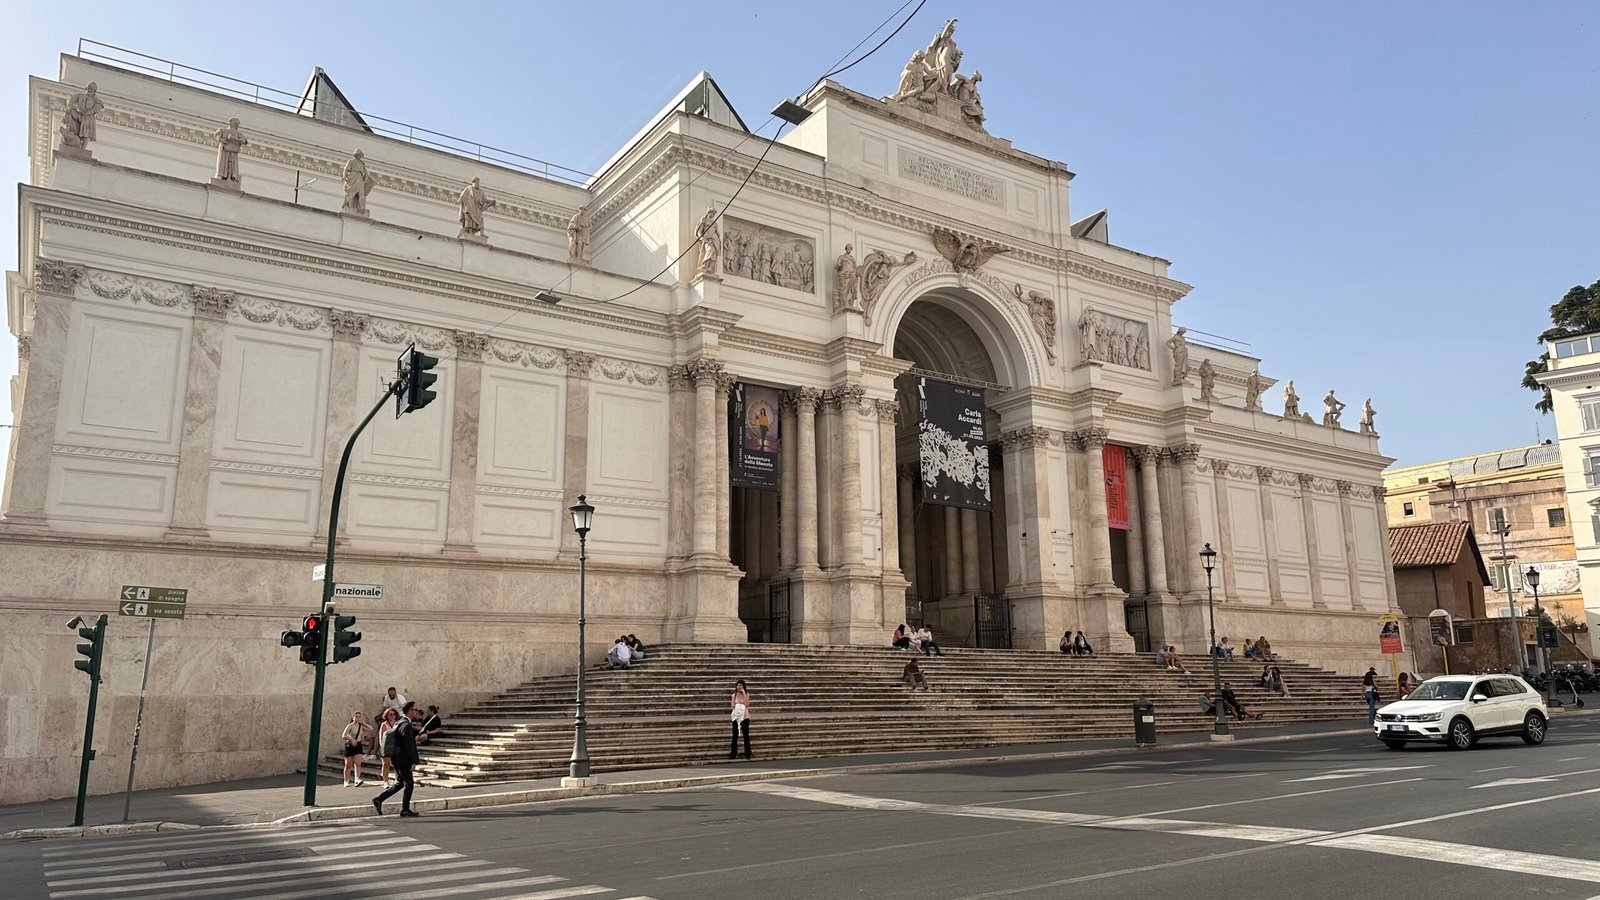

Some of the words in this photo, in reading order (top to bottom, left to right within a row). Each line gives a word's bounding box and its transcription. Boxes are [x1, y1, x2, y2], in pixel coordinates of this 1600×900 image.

[964, 408, 981, 417] Carla
[958, 414, 982, 425] Accardi
[335, 587, 381, 597] nazionale
